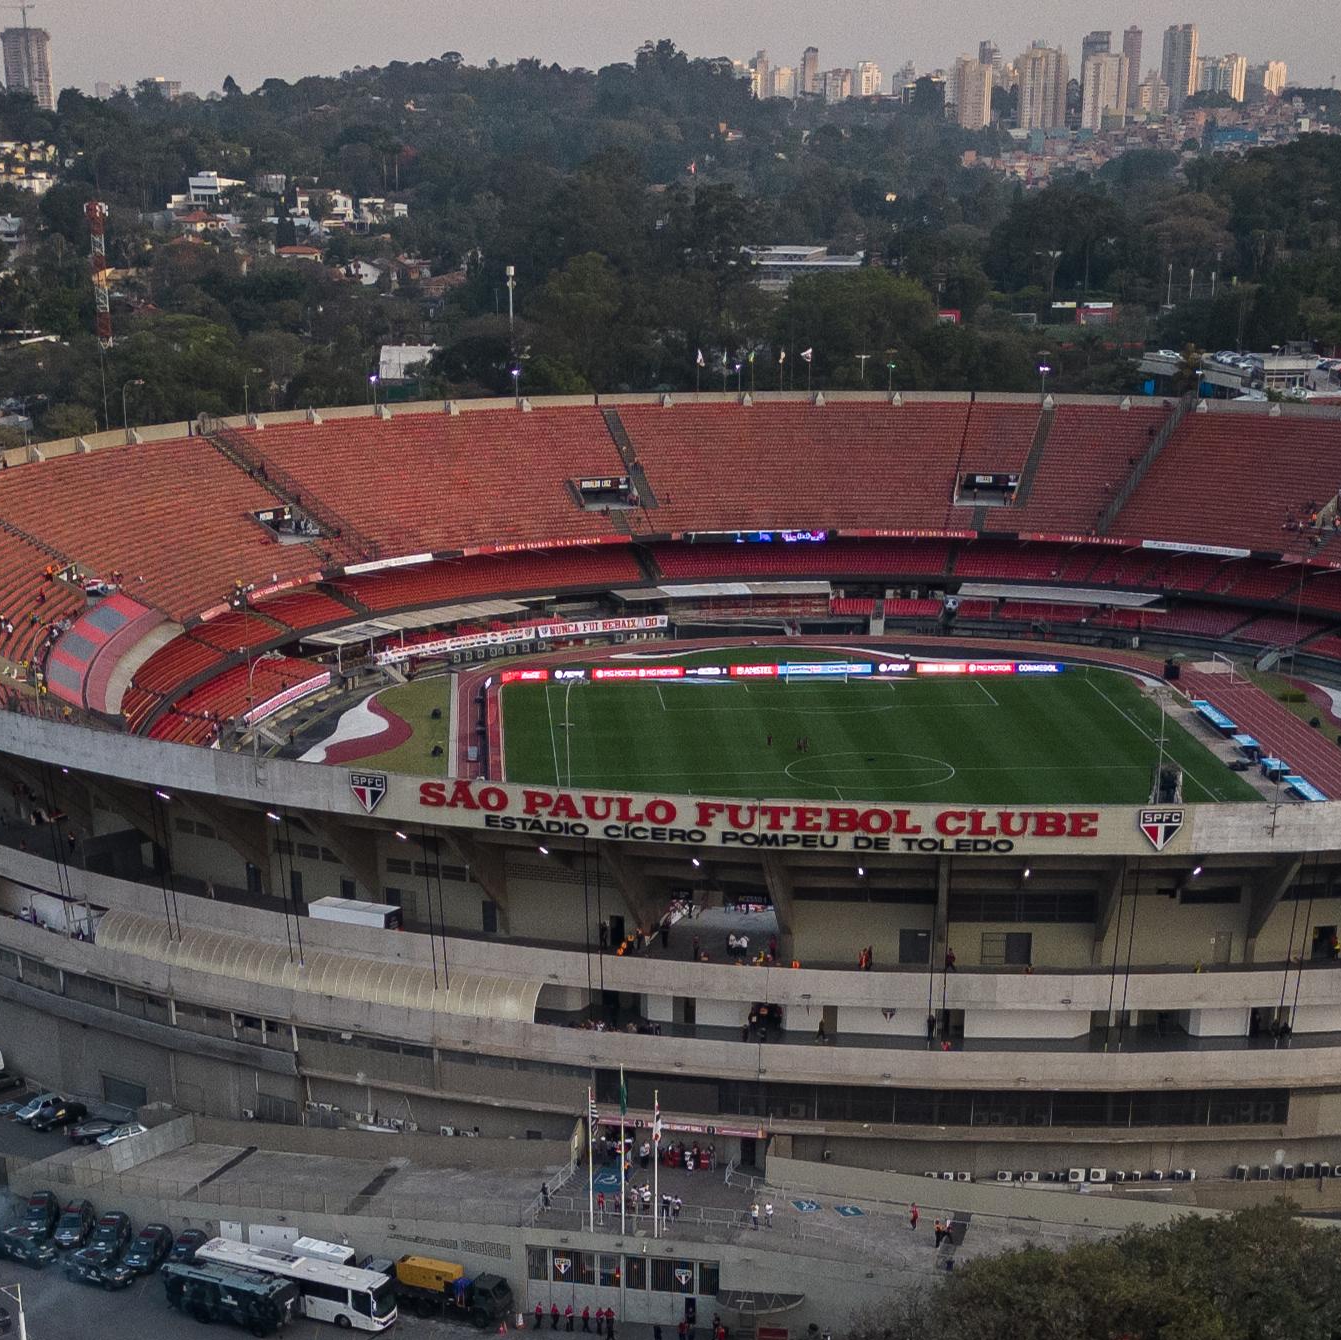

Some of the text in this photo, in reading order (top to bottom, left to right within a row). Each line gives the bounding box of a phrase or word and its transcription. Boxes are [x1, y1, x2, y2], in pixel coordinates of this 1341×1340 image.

[550, 622, 579, 635] NUNCA
[602, 616, 658, 630] REBAIXDO
[743, 666, 772, 675] AMSTEL
[352, 775, 384, 788] SPFC
[419, 780, 1099, 838] SÃO PAULO FUTEBOL CLUBE
[1142, 811, 1182, 824] SPFC
[485, 813, 1014, 854] ESTÁDIO CÍCERO POMPEU DE TOLEDO
